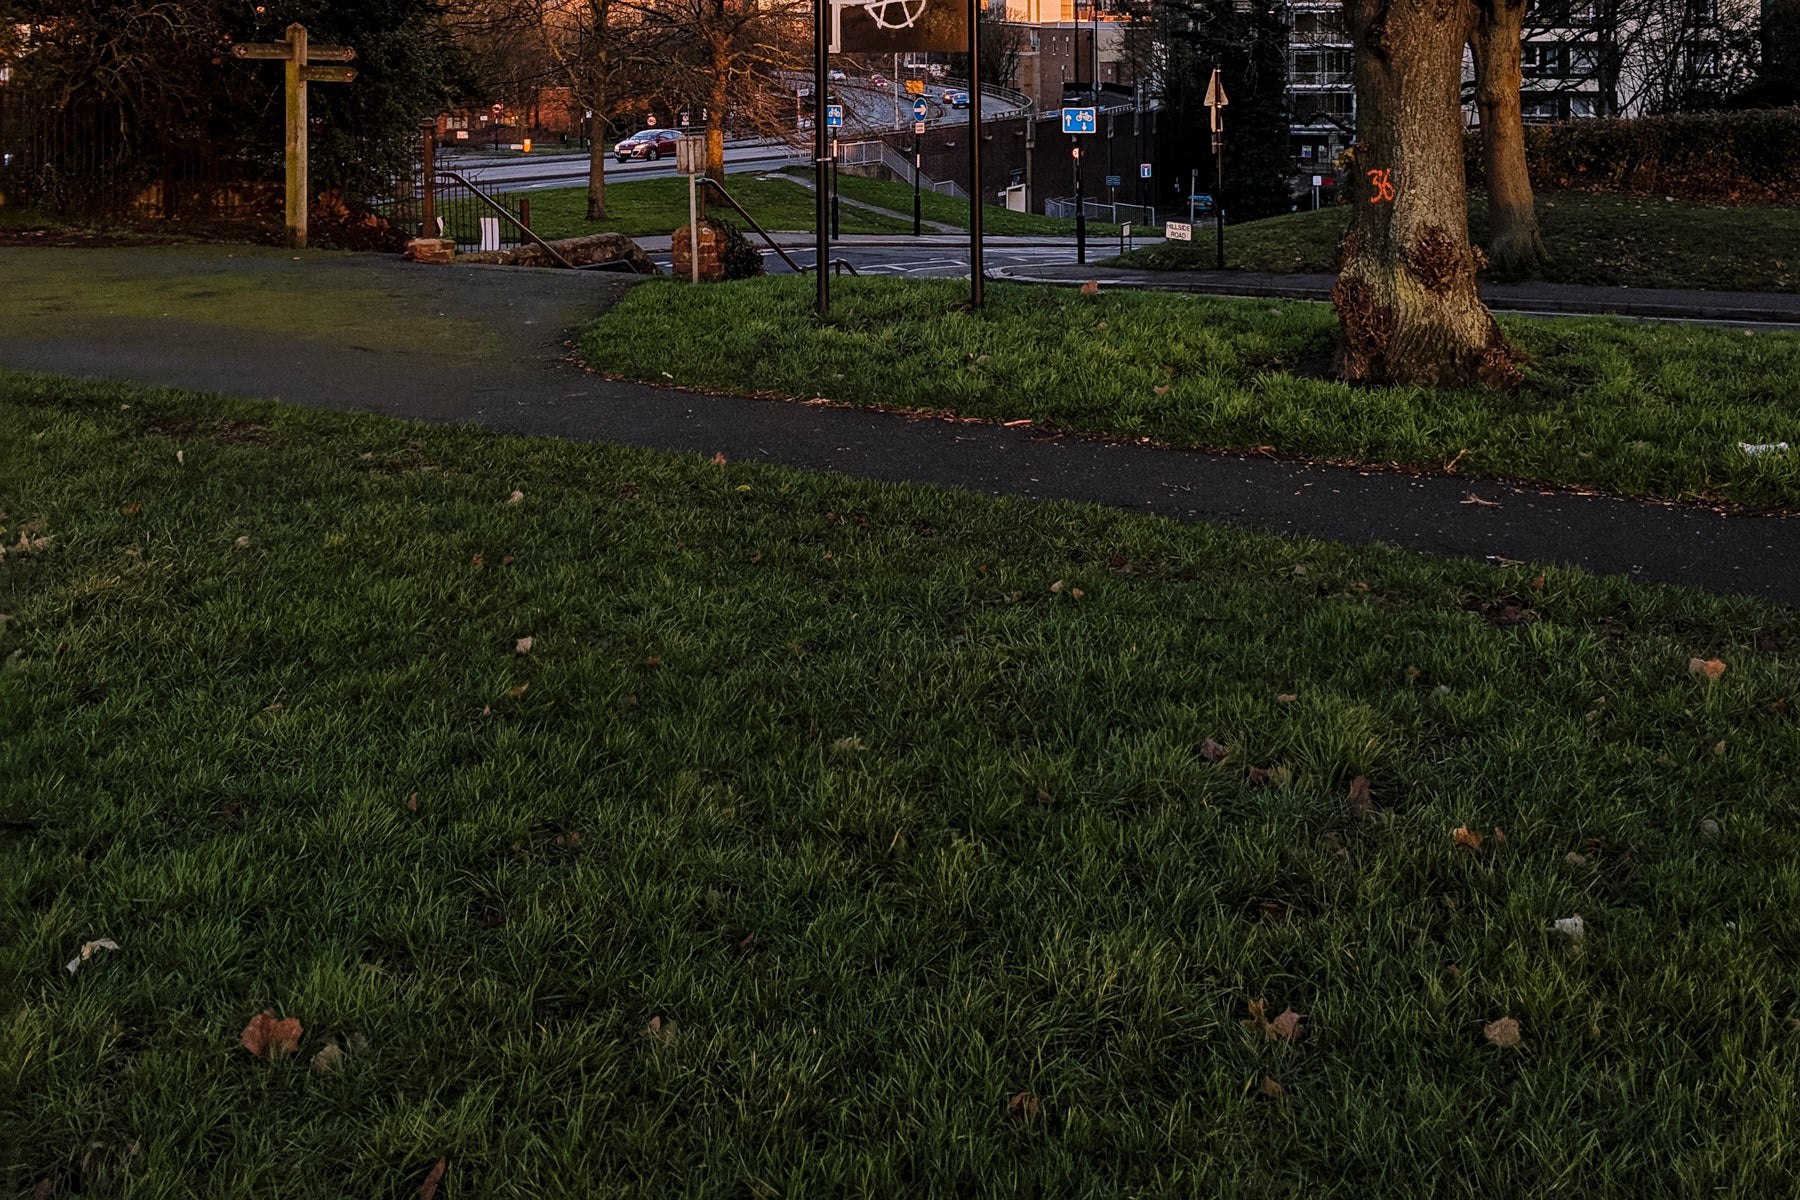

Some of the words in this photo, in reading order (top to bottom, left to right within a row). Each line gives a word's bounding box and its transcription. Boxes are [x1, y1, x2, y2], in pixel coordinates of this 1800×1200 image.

[1367, 168, 1394, 203] 36
[1166, 224, 1190, 232] HILLSIDE
[1170, 231, 1187, 239] ROAD
